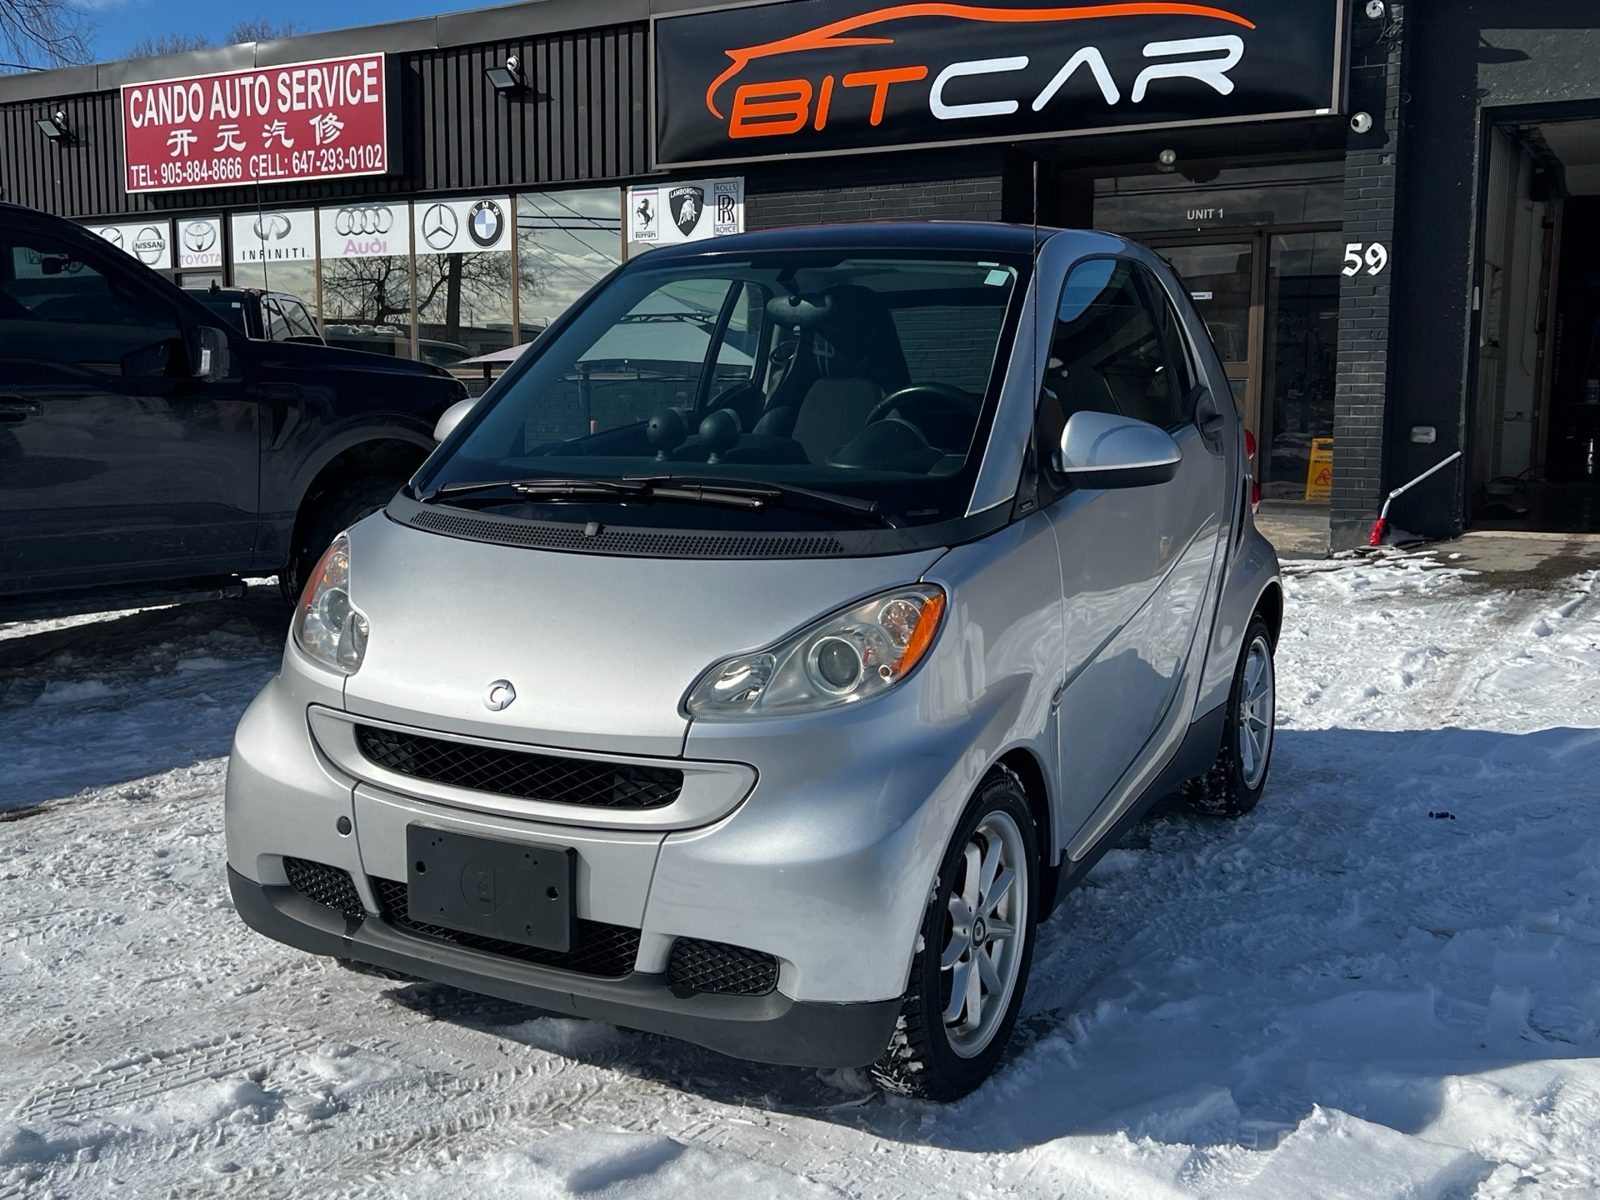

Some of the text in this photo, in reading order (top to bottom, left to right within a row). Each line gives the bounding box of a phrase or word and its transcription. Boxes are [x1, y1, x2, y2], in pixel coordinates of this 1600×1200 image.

[130, 61, 379, 128] CANDO AUTO SERVICE
[166, 112, 345, 157] 开元汽修
[130, 144, 383, 187] TEL: 905-884-8666 CELL: 647-293-0102
[715, 184, 737, 192] ROLLS
[1187, 208, 1224, 220] UNIT 1
[135, 240, 162, 249] NISSAN
[343, 239, 387, 255] Audi
[180, 253, 221, 266] TOYOTA
[242, 248, 306, 261] INFINITI
[1341, 242, 1388, 277] 59
